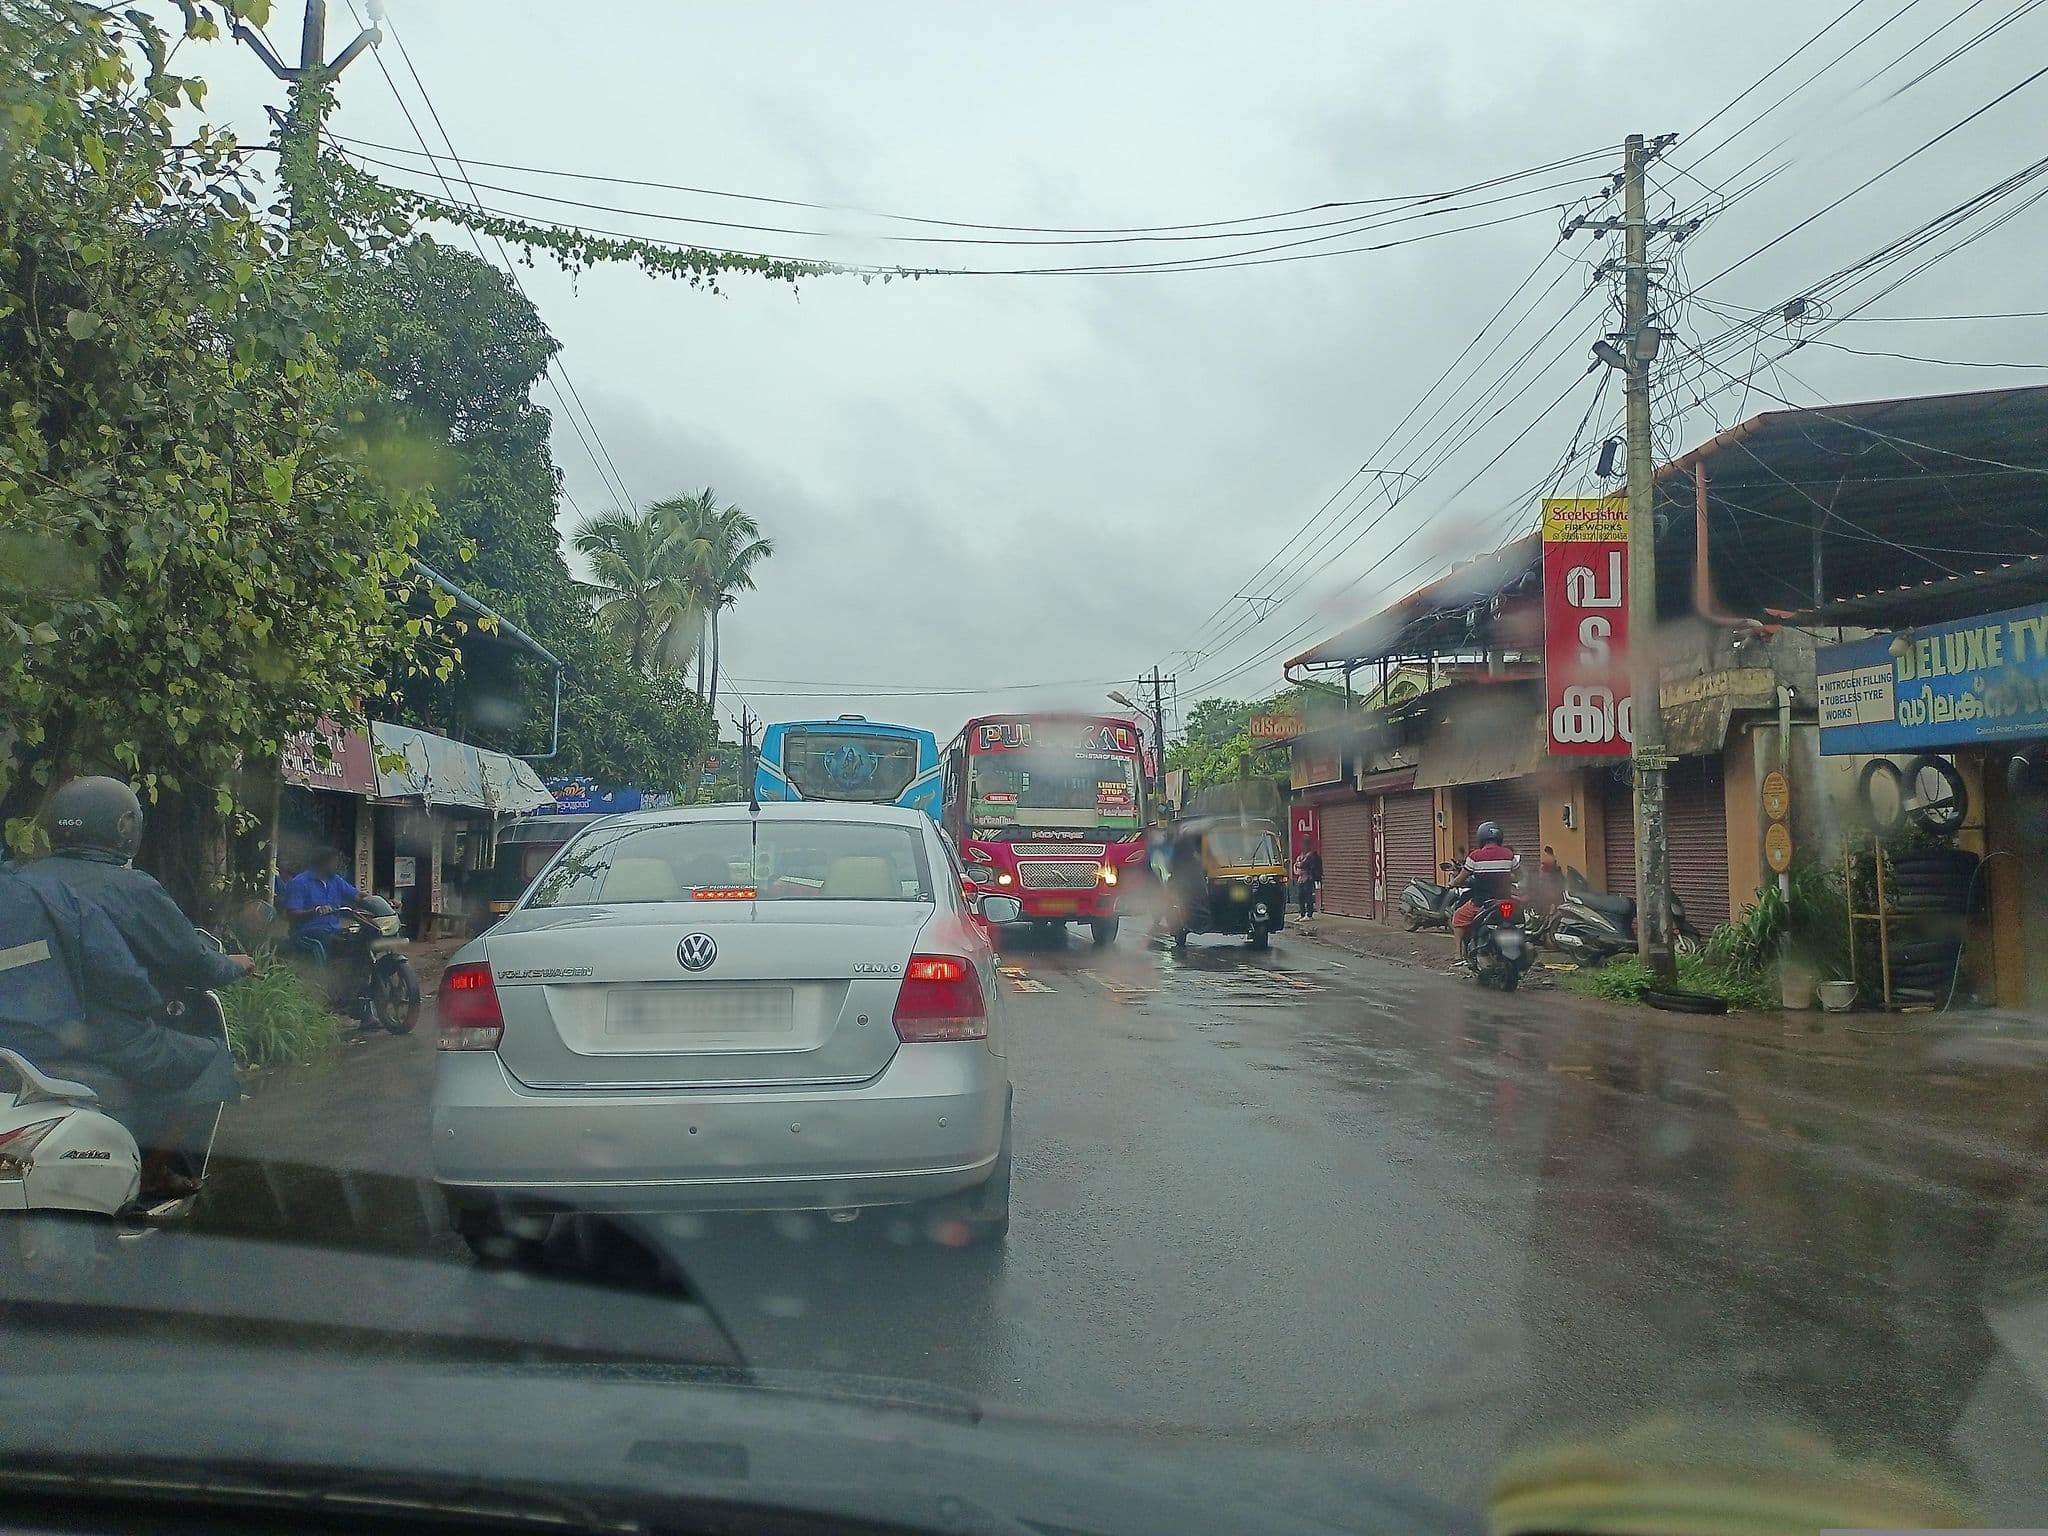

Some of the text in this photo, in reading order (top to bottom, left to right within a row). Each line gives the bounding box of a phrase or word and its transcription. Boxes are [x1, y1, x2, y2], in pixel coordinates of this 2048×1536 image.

[1897, 625, 2004, 683] DELUXE
[1824, 672, 1892, 692] NITROGEN FILLING
[1825, 689, 1884, 706] TUBELESS TYRE
[1825, 708, 1852, 721] WORKS
[1101, 788, 1123, 796] STOP
[498, 966, 594, 979] VOLKSWAGEN
